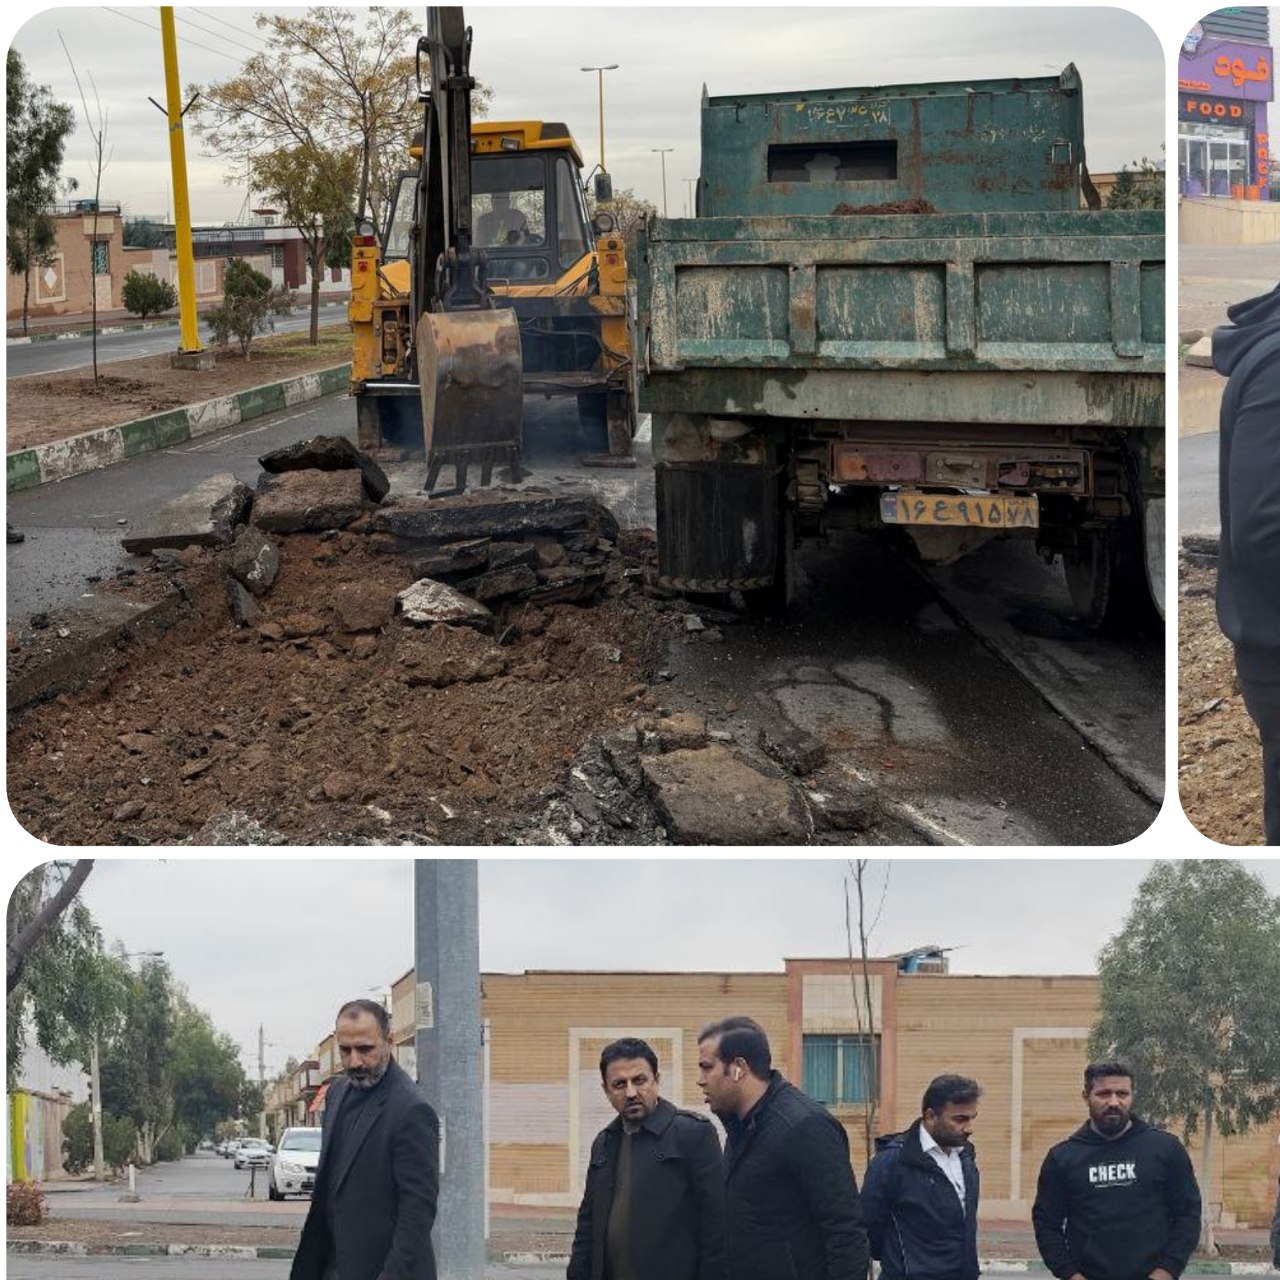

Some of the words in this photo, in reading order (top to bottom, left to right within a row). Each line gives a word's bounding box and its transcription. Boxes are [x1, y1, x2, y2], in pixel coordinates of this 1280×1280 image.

[1213, 56, 1270, 87] فود
[1185, 101, 1243, 117] FOOD
[1089, 1163, 1136, 1182] CHECK
